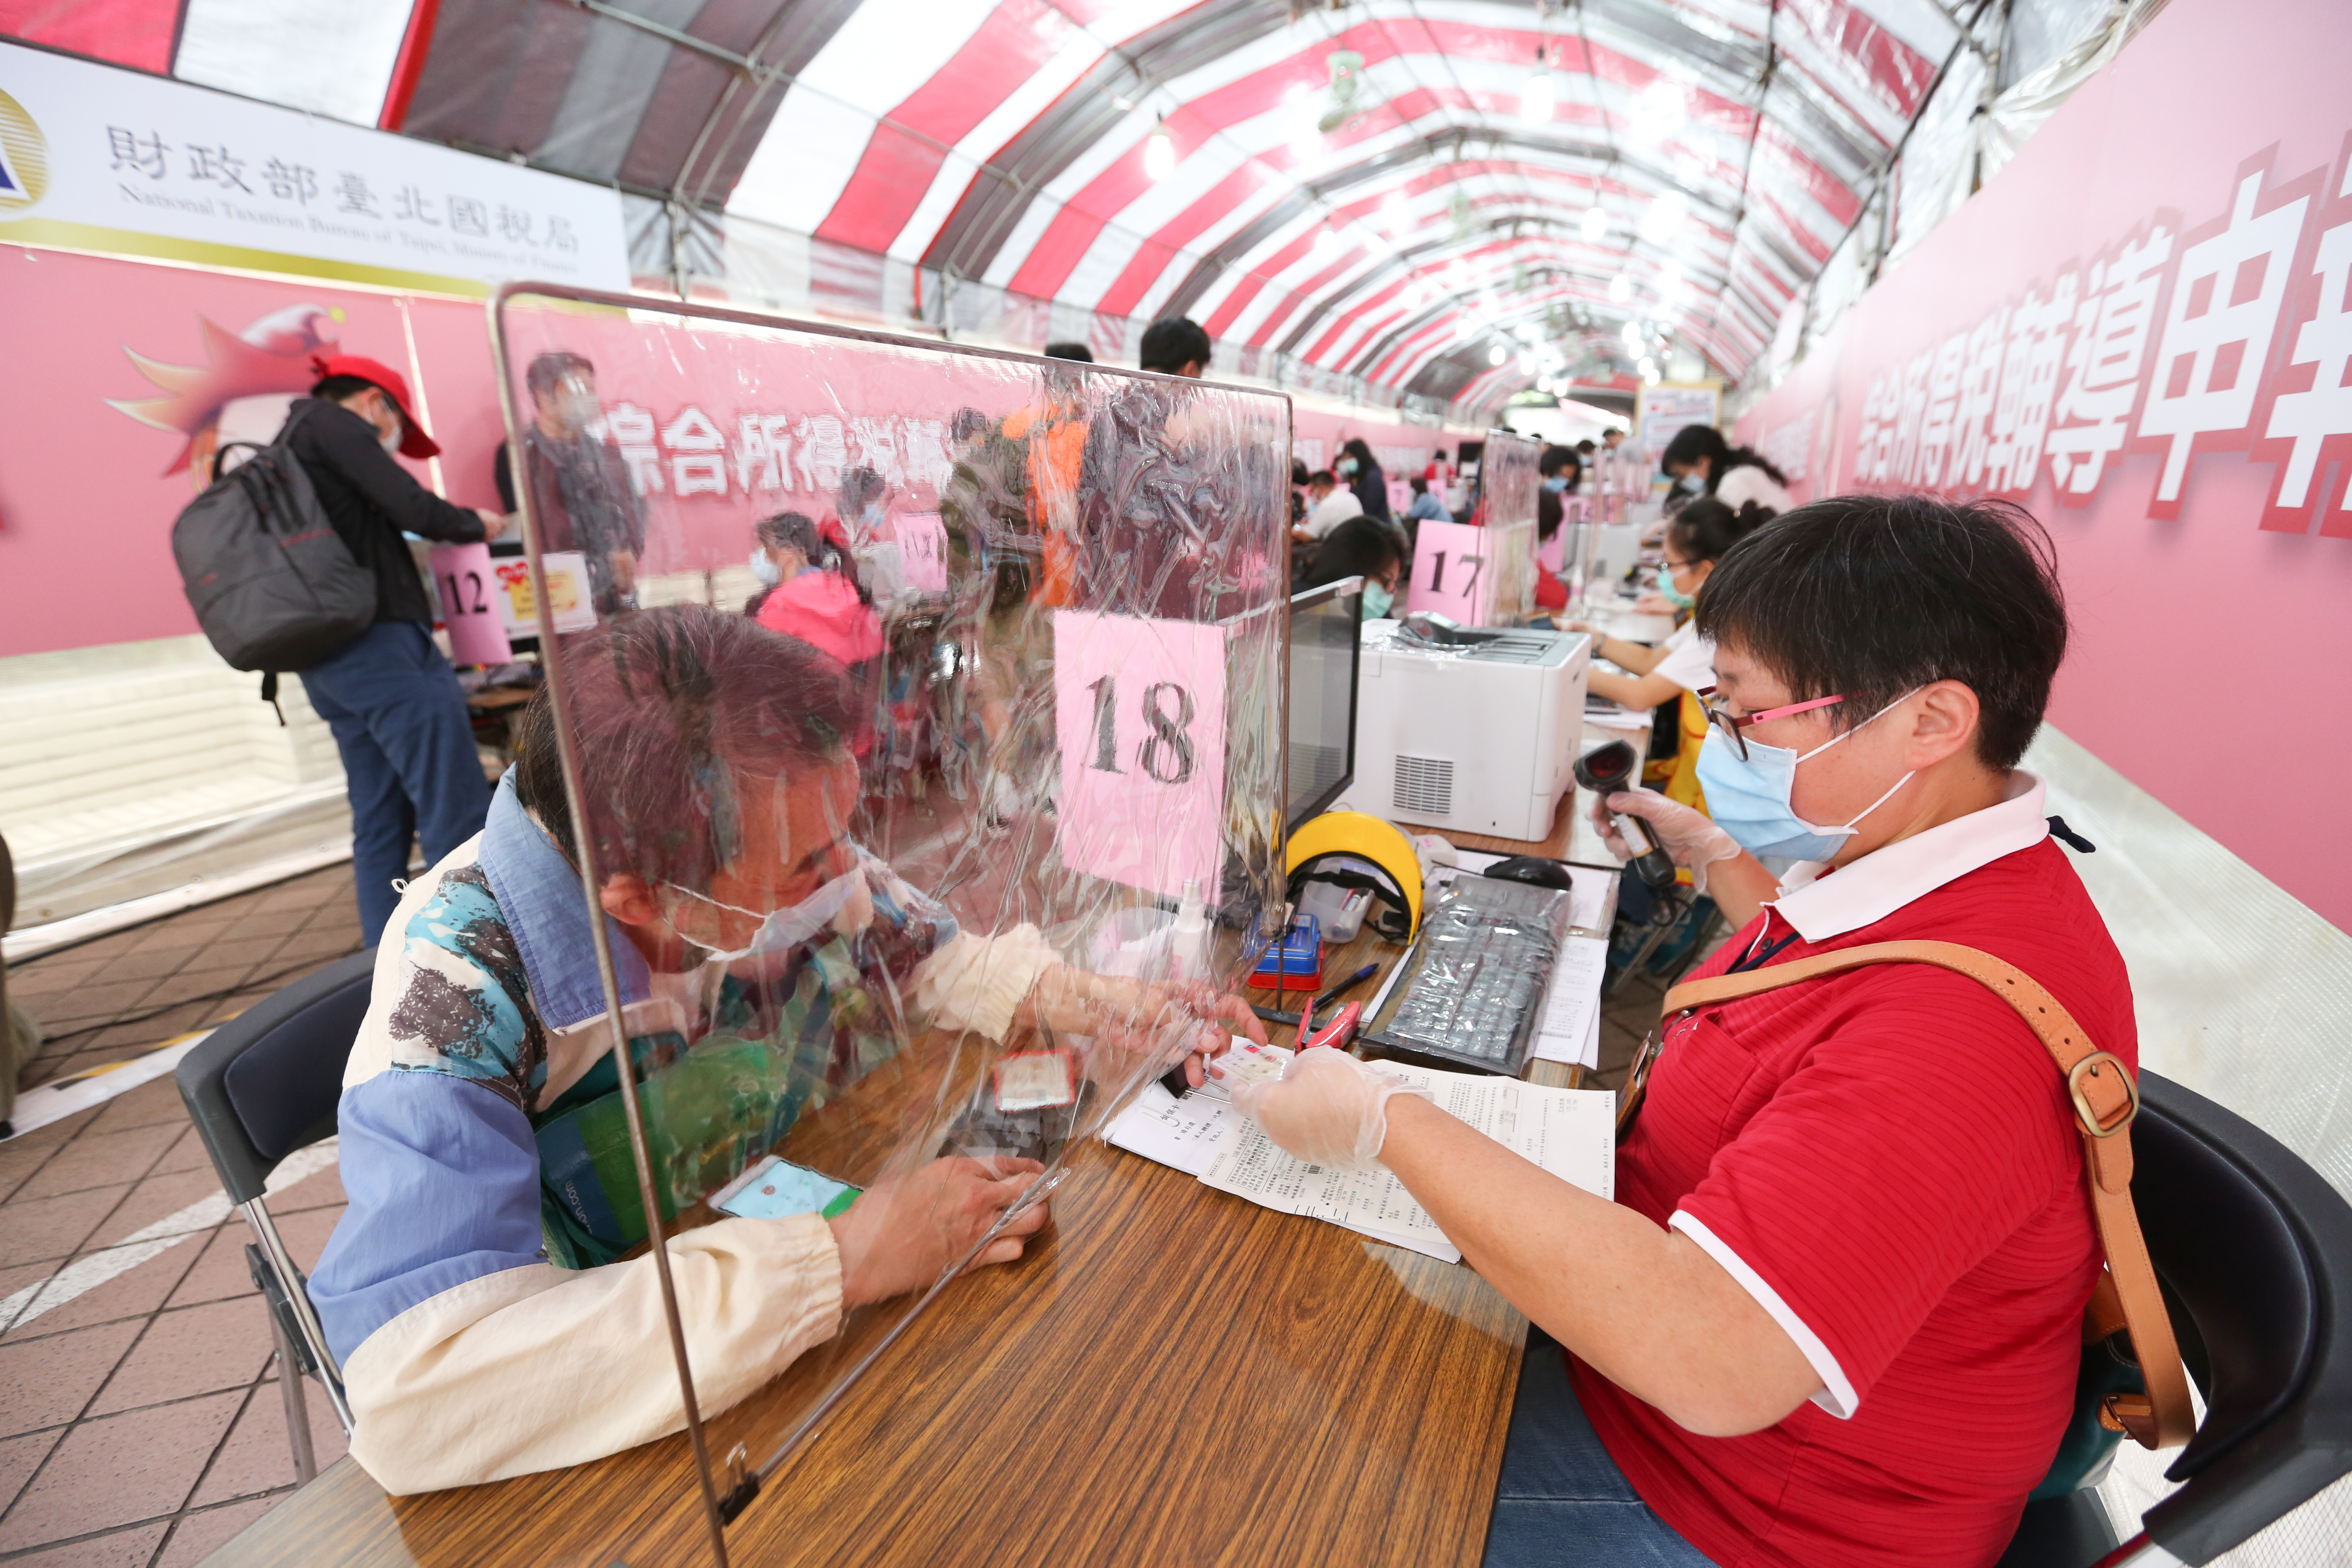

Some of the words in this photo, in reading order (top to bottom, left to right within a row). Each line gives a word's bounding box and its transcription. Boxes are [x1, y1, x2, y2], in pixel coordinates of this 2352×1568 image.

[106, 124, 579, 254] 財政部臺北國稅局
[118, 182, 216, 217] National
[220, 201, 305, 231] Taxation
[309, 215, 368, 241] Bureau
[373, 229, 392, 244] of
[447, 571, 488, 615] 12
[1427, 550, 1485, 598] 17
[1086, 674, 1196, 786] 18
